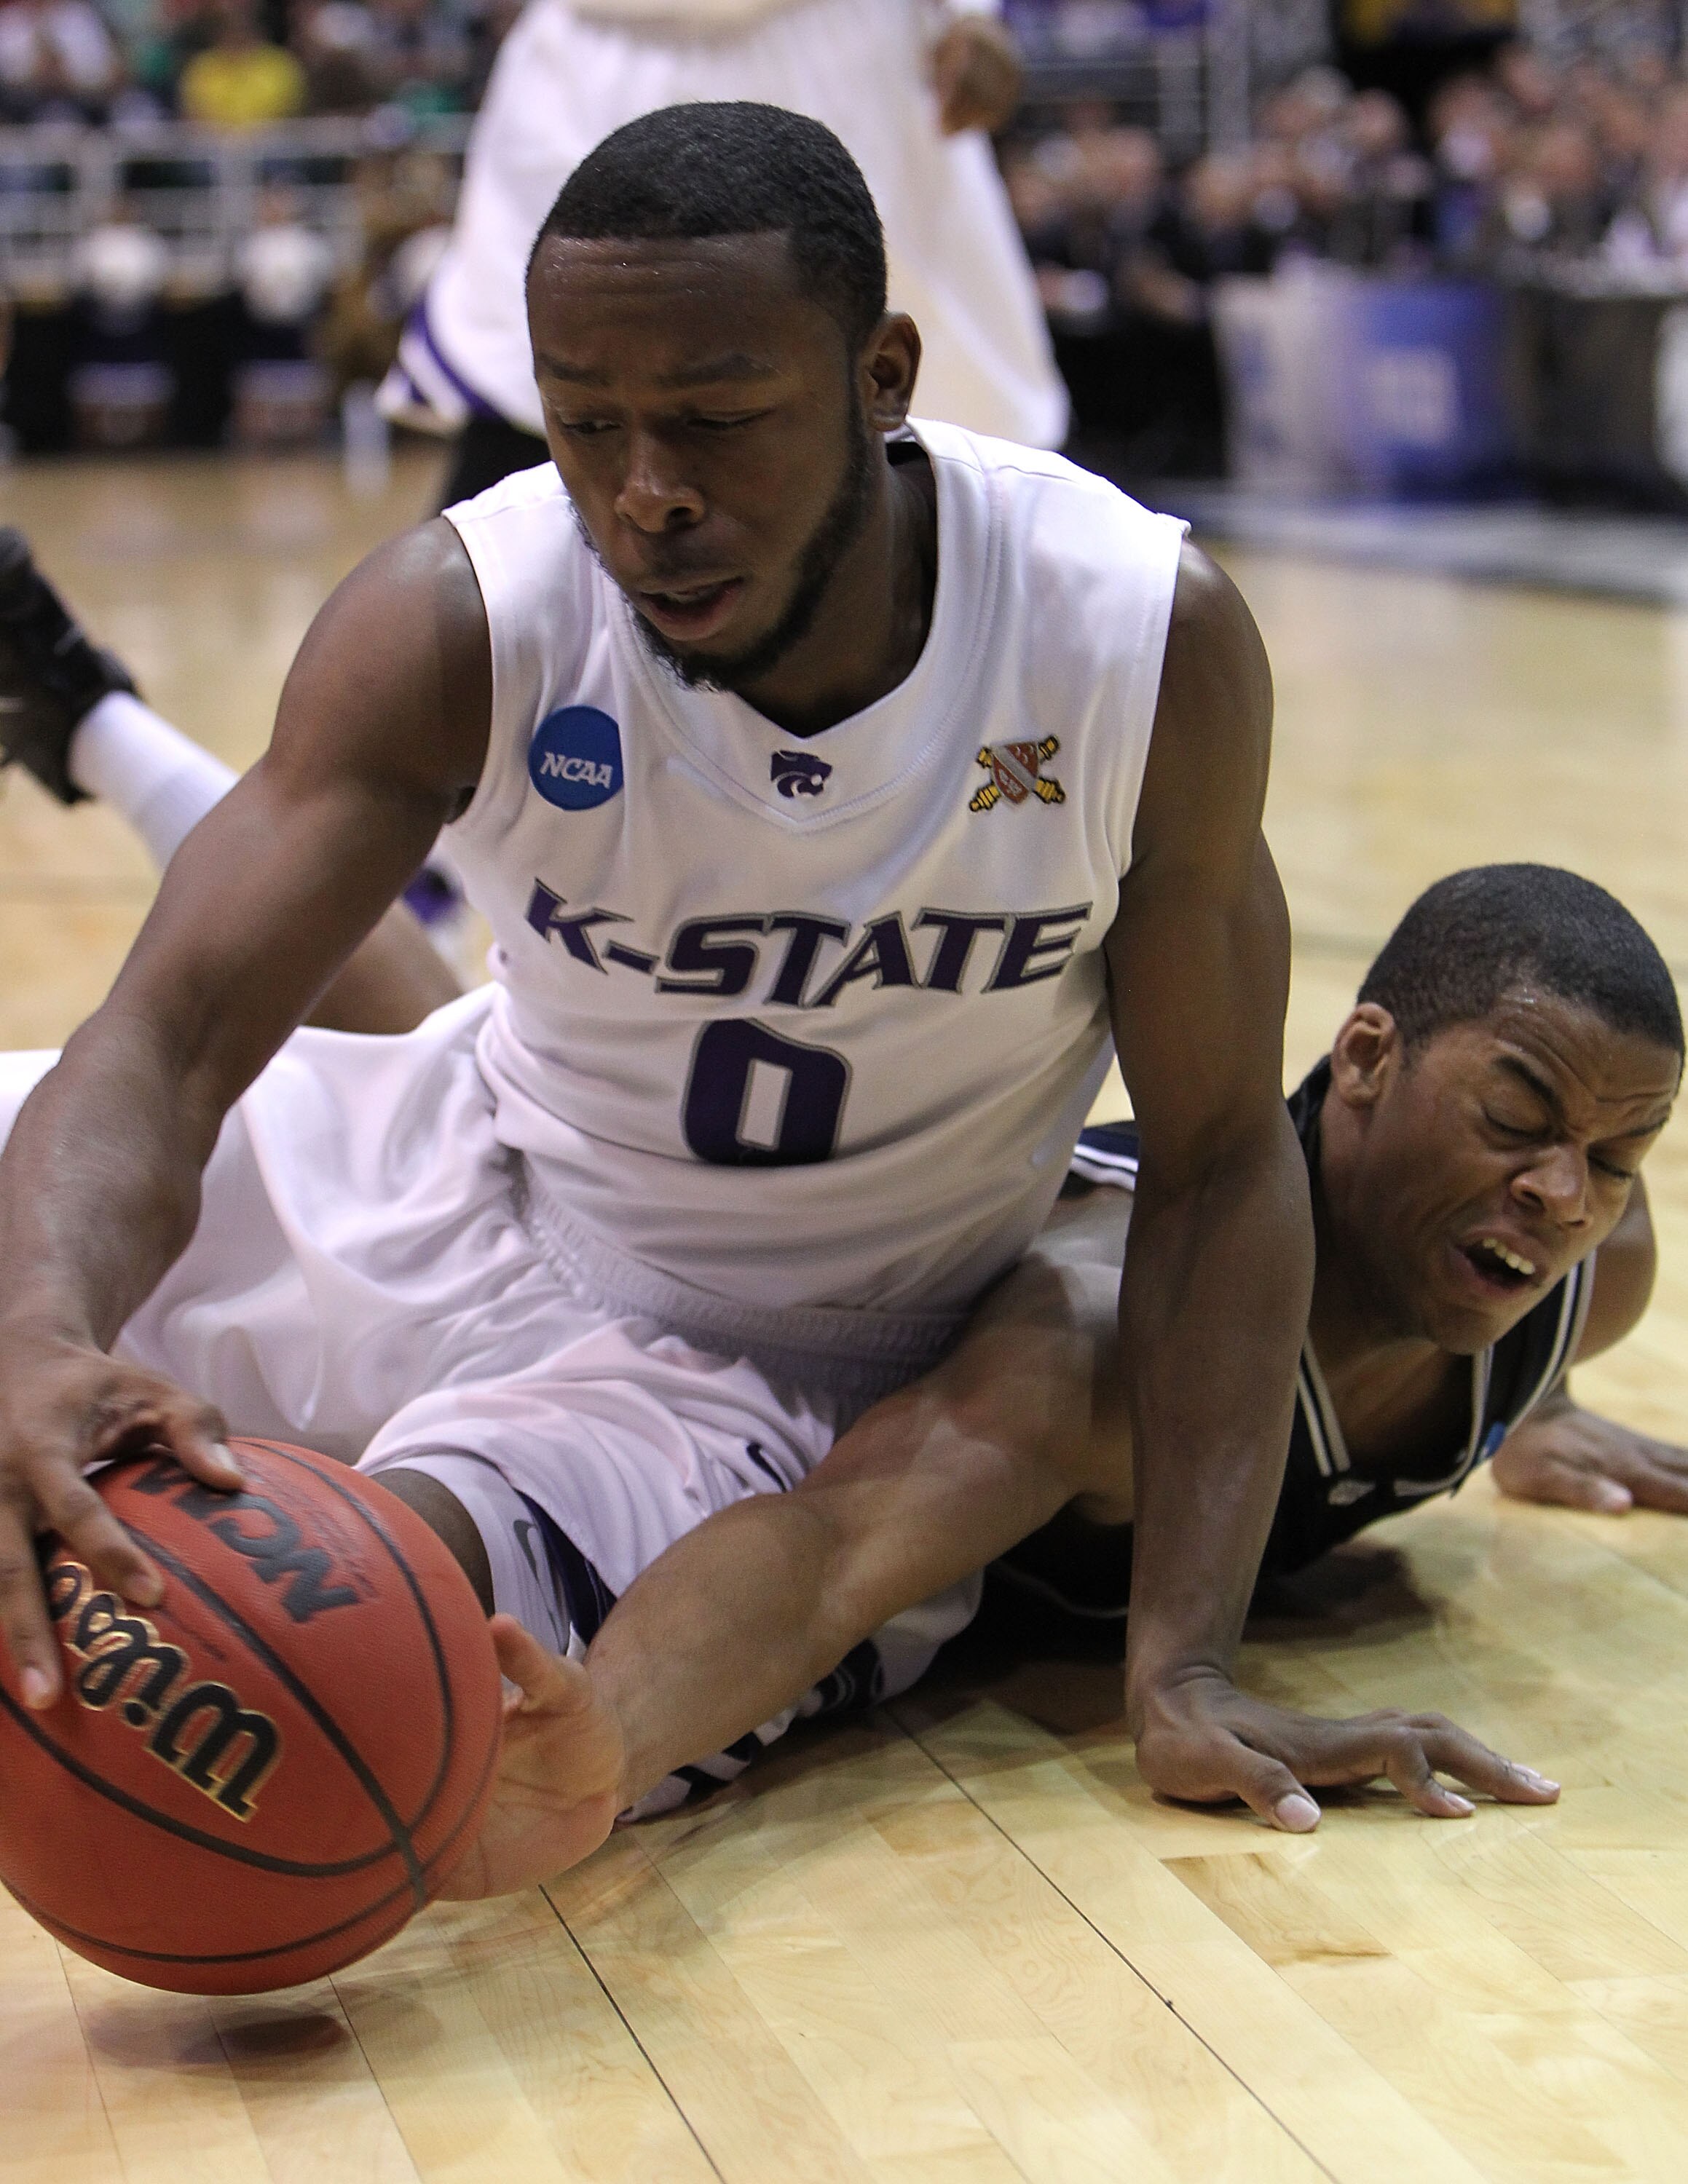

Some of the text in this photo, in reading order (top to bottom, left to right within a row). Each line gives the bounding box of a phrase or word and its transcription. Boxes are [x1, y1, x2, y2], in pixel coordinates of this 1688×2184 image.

[539, 751, 613, 789] NCAA
[526, 879, 1094, 1009] K-STATE
[680, 1018, 853, 1164] 0
[42, 1560, 283, 1823] Wilso
